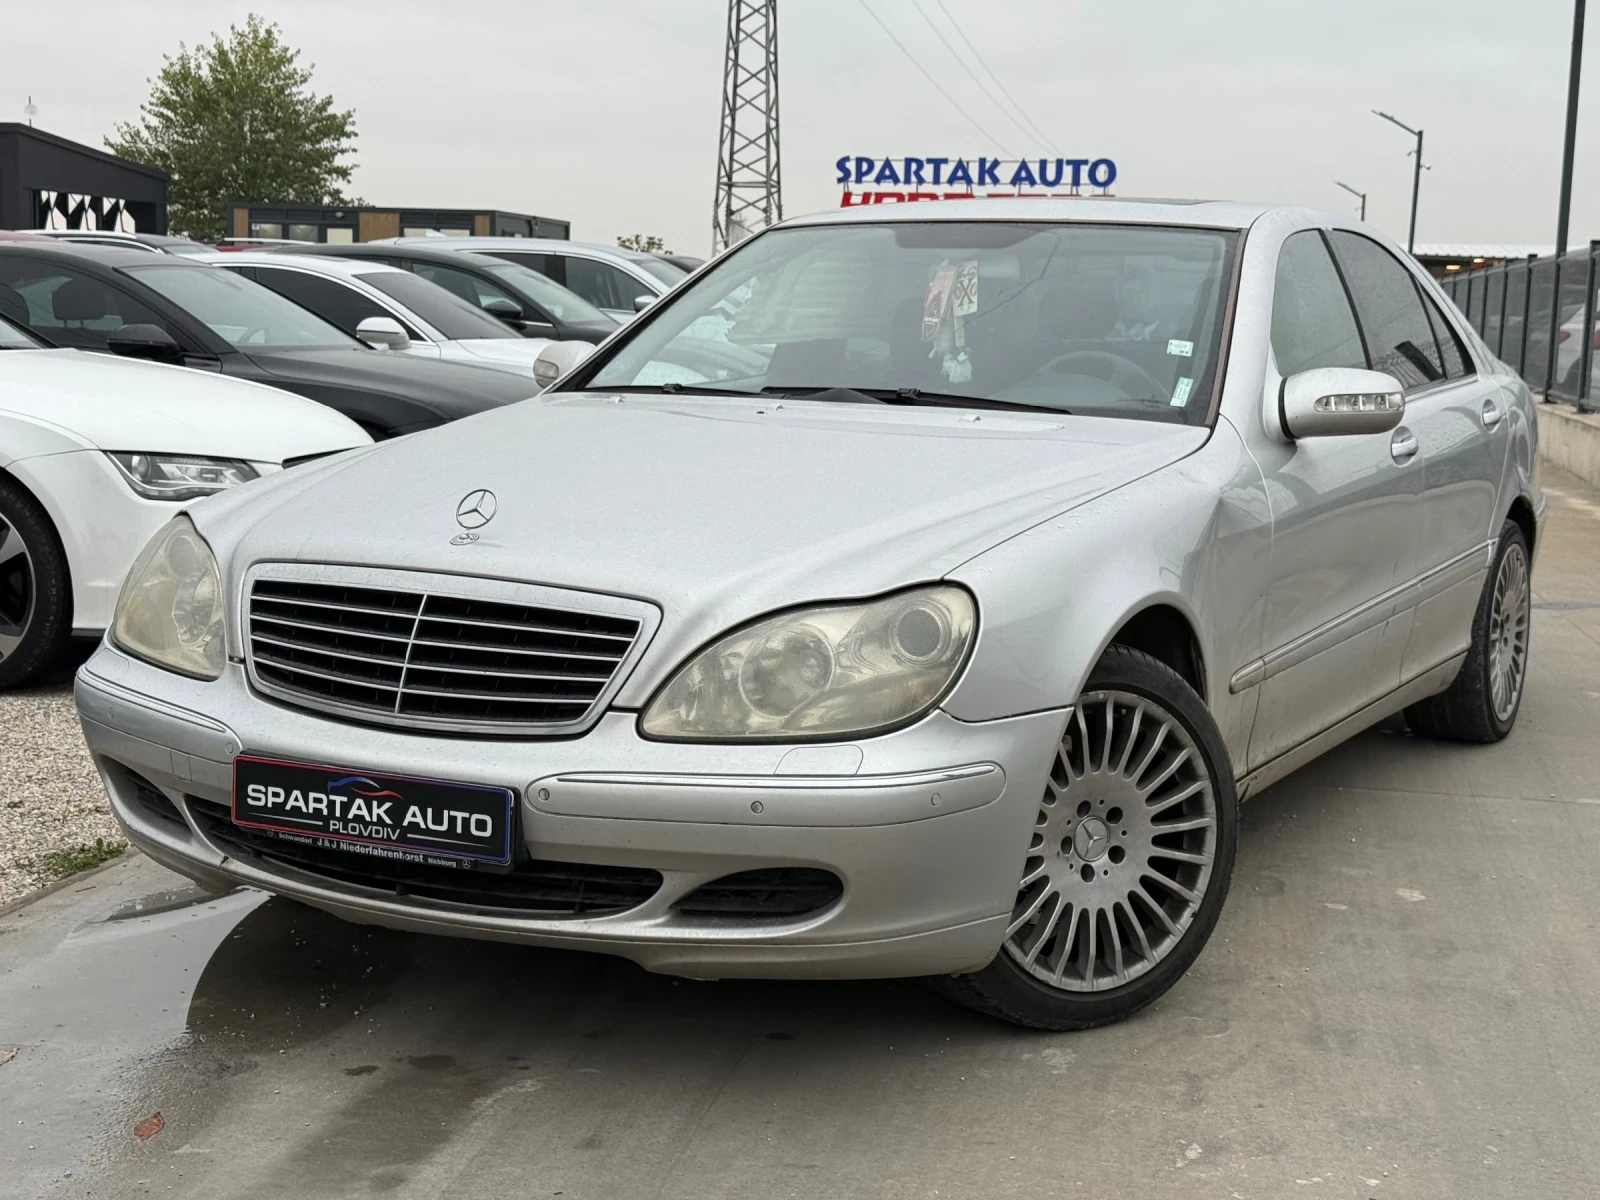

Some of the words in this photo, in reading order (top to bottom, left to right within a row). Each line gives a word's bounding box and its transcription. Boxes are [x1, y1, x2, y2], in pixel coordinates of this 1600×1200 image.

[836, 156, 1001, 186] SPARTAK
[1010, 157, 1117, 188] AUTO
[247, 784, 393, 824] SPARTAK
[402, 805, 493, 838] AUTO
[329, 820, 401, 840] PLOVDIV
[324, 839, 331, 847] &
[331, 840, 337, 849] J
[340, 841, 424, 863] Niederfahrenhorst
